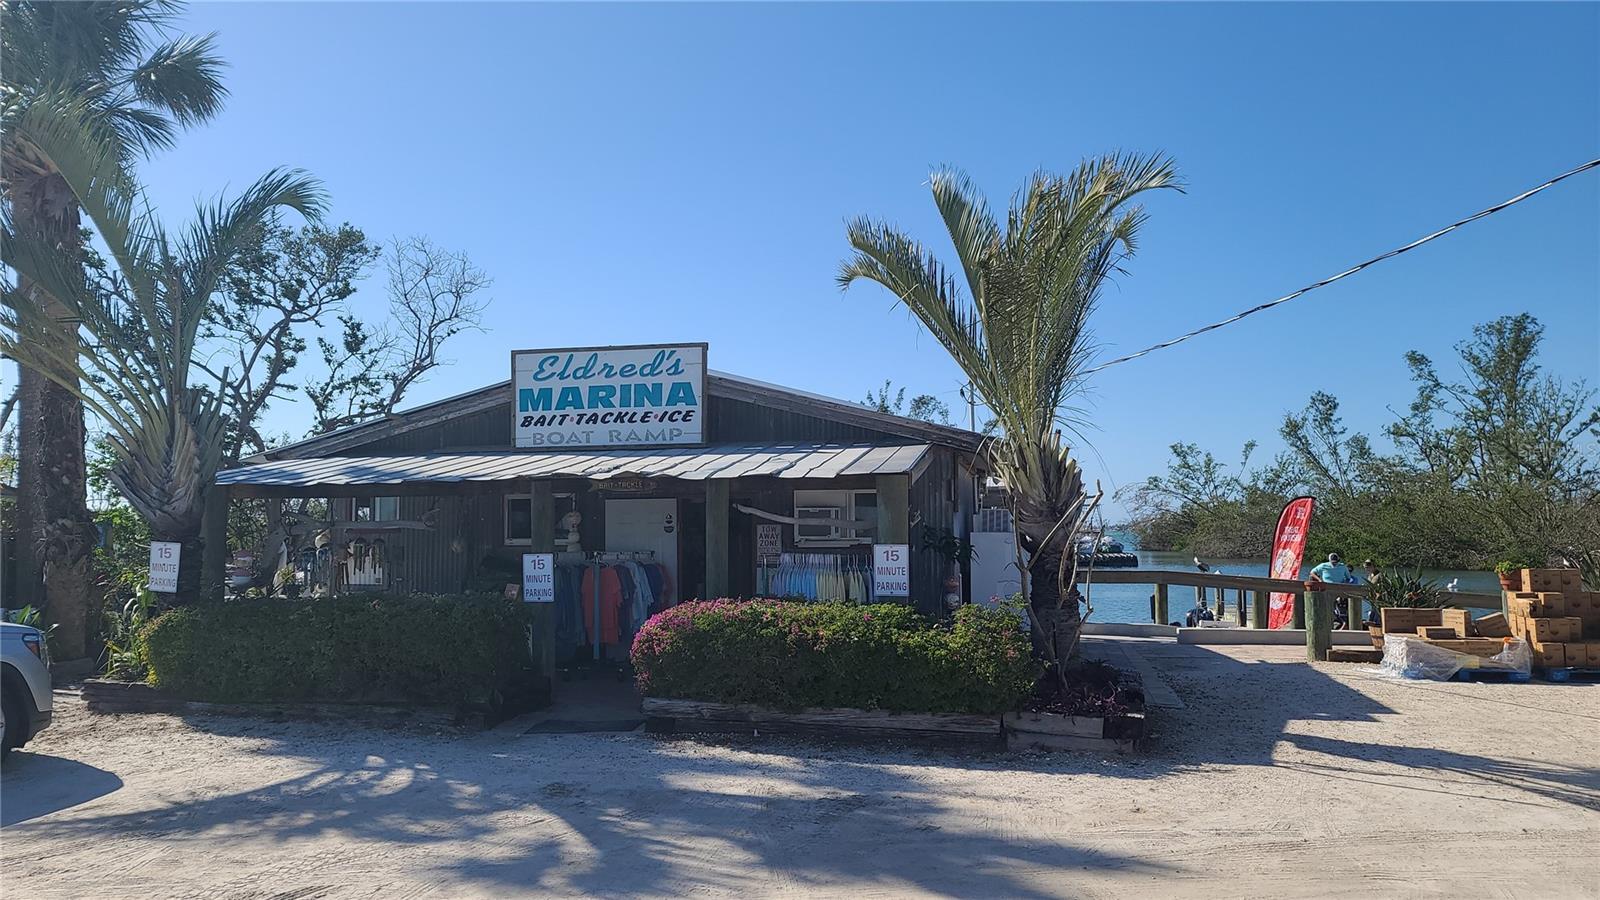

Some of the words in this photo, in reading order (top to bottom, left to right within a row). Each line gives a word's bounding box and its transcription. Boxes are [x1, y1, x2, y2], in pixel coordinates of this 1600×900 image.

[532, 350, 684, 381] Eldred's
[519, 382, 697, 412] MARINA
[520, 414, 569, 427] BAIT
[576, 411, 652, 425] TACKLE
[658, 410, 696, 422] ICE
[532, 430, 594, 445] BOAT
[608, 428, 683, 443] RAMP
[158, 547, 172, 559] 15
[883, 550, 900, 562] 15
[152, 563, 177, 573] MINUTE
[531, 559, 545, 570] 15
[877, 566, 906, 576] MINUTE
[151, 577, 176, 588] PARKING
[525, 574, 551, 583] MINUTE
[876, 581, 907, 591] PARKING
[525, 588, 552, 598] PARKING
